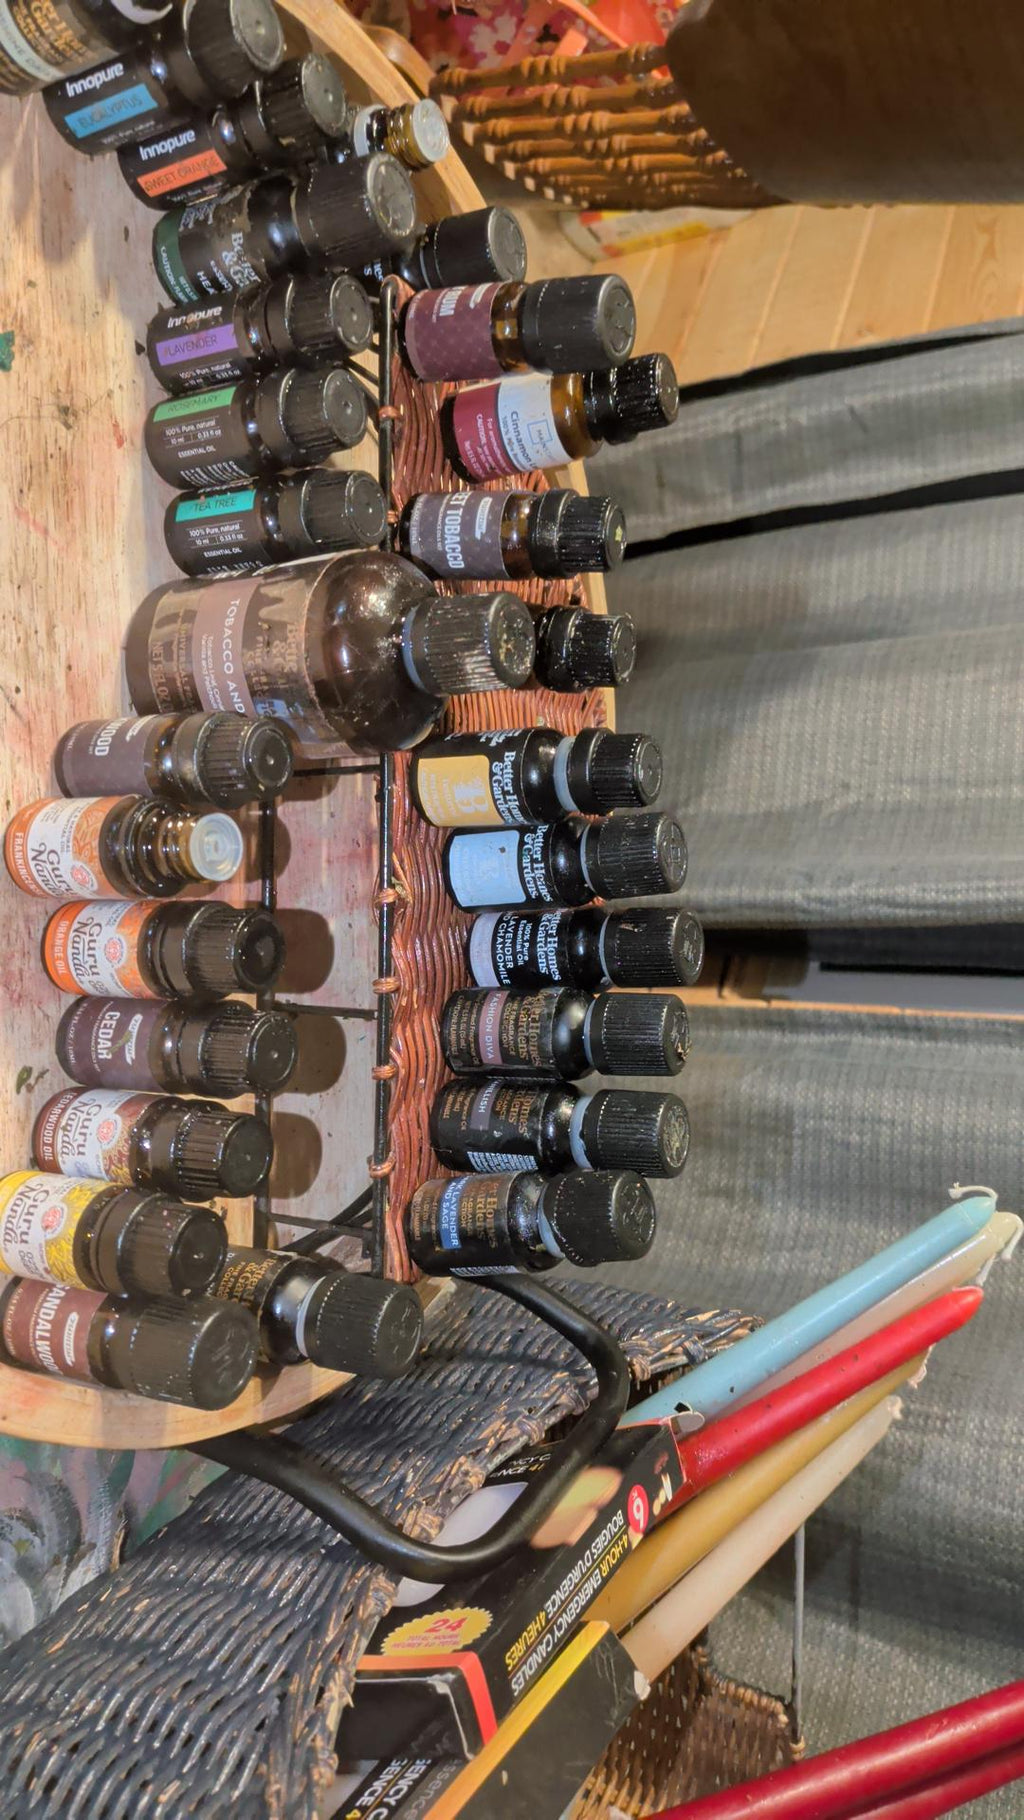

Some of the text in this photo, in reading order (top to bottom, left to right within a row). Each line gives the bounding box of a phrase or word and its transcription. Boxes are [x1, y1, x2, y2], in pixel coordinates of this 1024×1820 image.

[65, 62, 124, 97] Innopure
[138, 129, 196, 161] Innopure
[178, 157, 219, 177] ORANGE
[168, 334, 217, 356] LAVENDER
[167, 395, 218, 413] ROSEMARY
[196, 418, 216, 430] natural
[178, 444, 216, 458] ESSENTIAL OIL
[510, 411, 533, 463] Cinnamon
[214, 496, 237, 510] TREE
[220, 522, 240, 533] natural
[203, 549, 232, 558] ESSENTIAL
[222, 598, 246, 713] TOBACCO AND
[503, 751, 517, 793] Better
[533, 824, 550, 861] Better
[30, 842, 65, 898] Nanda
[47, 849, 80, 898] Guru
[54, 921, 70, 975] ORANGE OIL
[71, 916, 94, 977] Nanda
[87, 923, 103, 976] Guru
[496, 923, 511, 985] CHAMOMILE
[504, 916, 519, 969] LAVENDER
[516, 920, 527, 952] Essential
[523, 922, 533, 940] 100%
[547, 912, 562, 981] etter Homes
[97, 1011, 121, 1060] CEDAR
[485, 993, 502, 1059] FASHION DIVA
[507, 1010, 517, 1056] FRAGRANCE
[529, 1022, 543, 1067] Homes
[60, 1098, 97, 1158] Nanda
[77, 1104, 102, 1156] Guru
[43, 1146, 54, 1161] OIL
[3, 1183, 44, 1246] Nanda
[19, 1190, 50, 1244] Guru
[441, 1182, 457, 1230] AND SAGE
[449, 1191, 461, 1246] LAVENDER
[35, 1284, 71, 1375] SANDALWOO
[590, 1510, 625, 1556] BOUGIES
[633, 1497, 644, 1530] 6
[543, 1550, 593, 1620] D'URGENCE
[424, 1617, 468, 1633] 24
[510, 1534, 629, 1697] 4-HOUR EMERGENCY CANDLES
